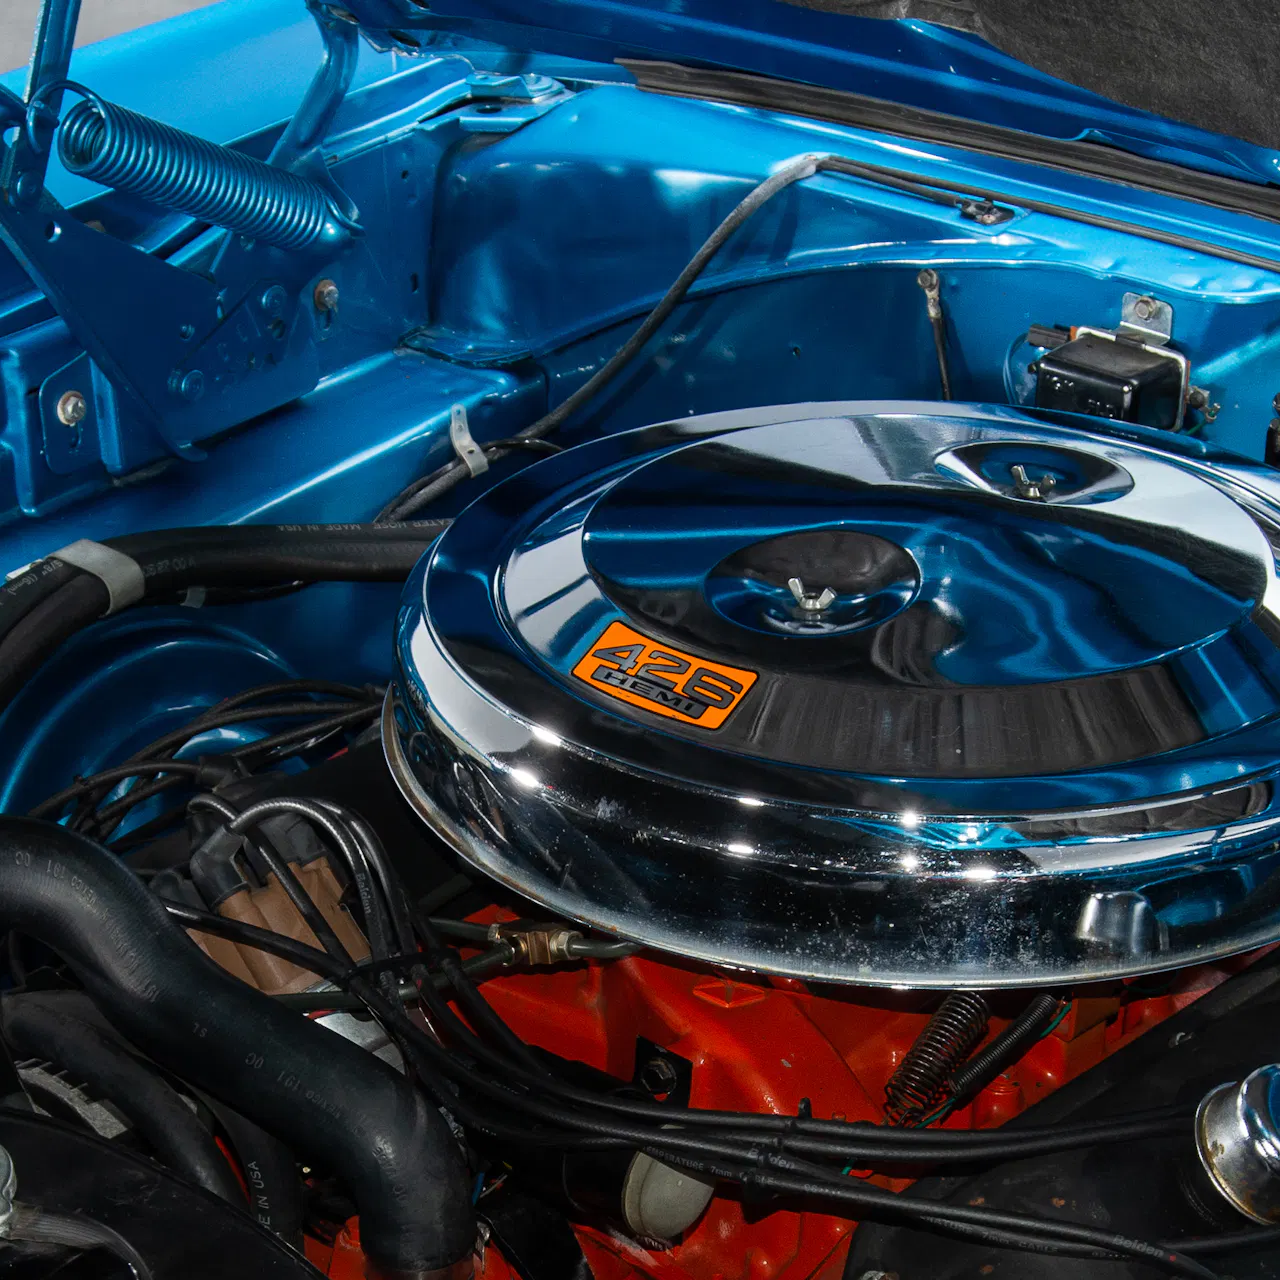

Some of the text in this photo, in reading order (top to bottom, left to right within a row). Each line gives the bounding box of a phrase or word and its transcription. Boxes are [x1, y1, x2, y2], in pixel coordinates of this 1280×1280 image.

[592, 643, 743, 709] 426
[600, 668, 699, 714] HEMI
[247, 1160, 265, 1189] USA
[257, 1195, 271, 1210] IN
[1112, 1233, 1166, 1259] Belden
